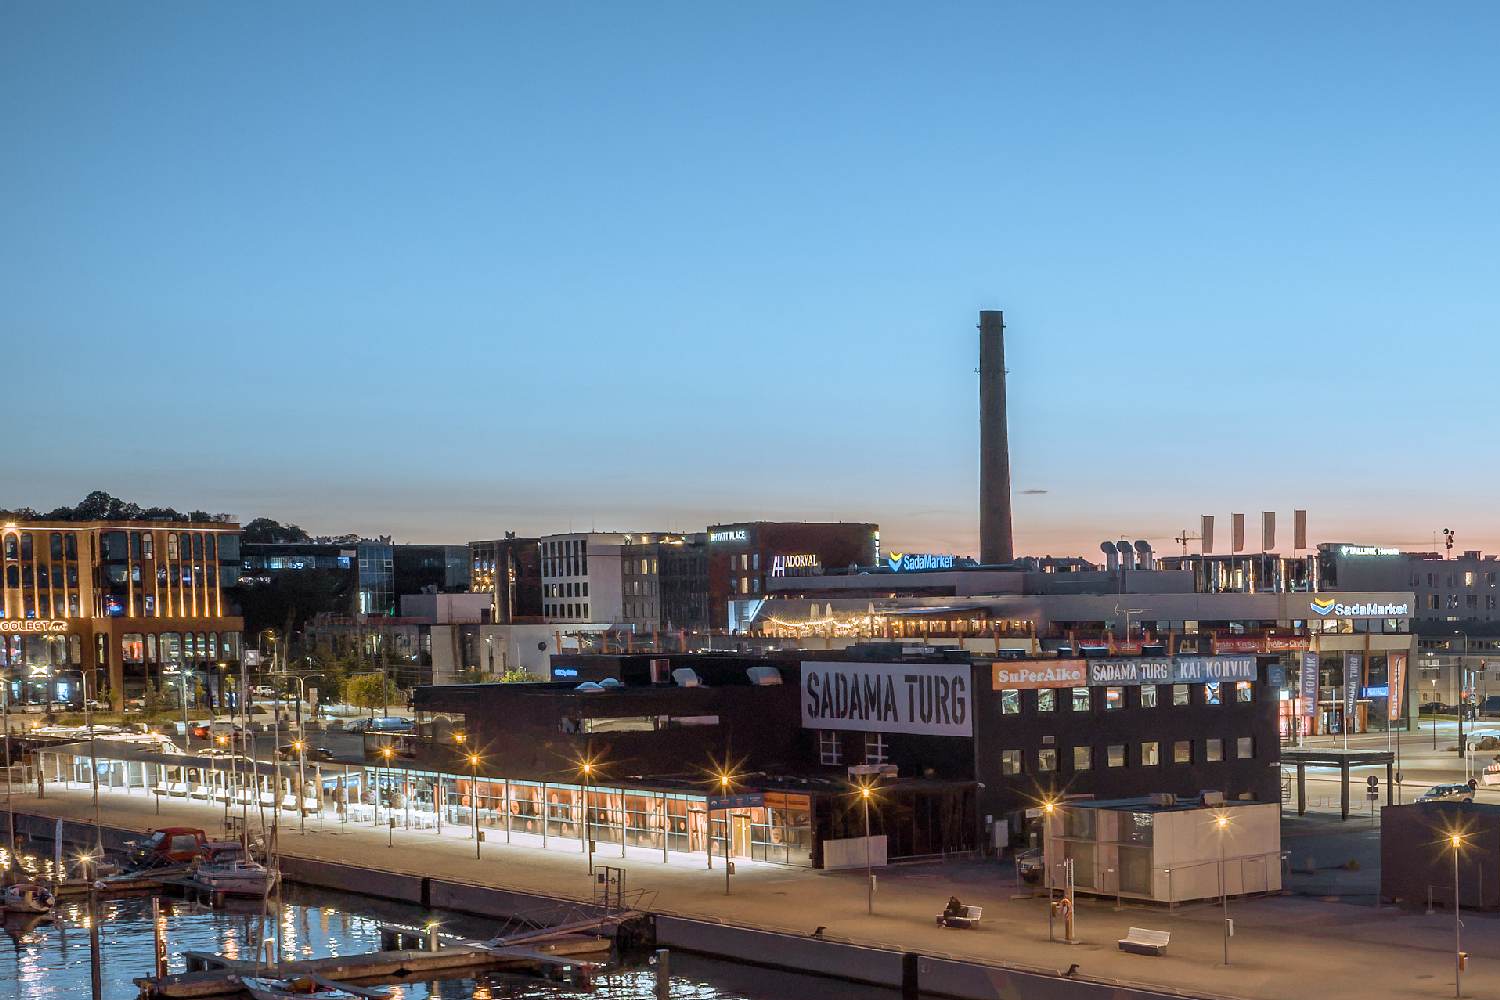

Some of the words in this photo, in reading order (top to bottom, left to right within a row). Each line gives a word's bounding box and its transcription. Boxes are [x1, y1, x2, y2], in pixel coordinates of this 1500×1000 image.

[903, 554, 954, 571] SadaMarket
[1334, 602, 1408, 616] SadaMarket
[0, 620, 50, 632] OOLBET
[1092, 664, 1137, 681] SADAMA
[1141, 663, 1168, 680] TURG
[1180, 662, 1200, 679] KAI
[1205, 660, 1251, 678] KOHVIK
[807, 671, 899, 722] SADAMA
[904, 674, 966, 725] TURG
